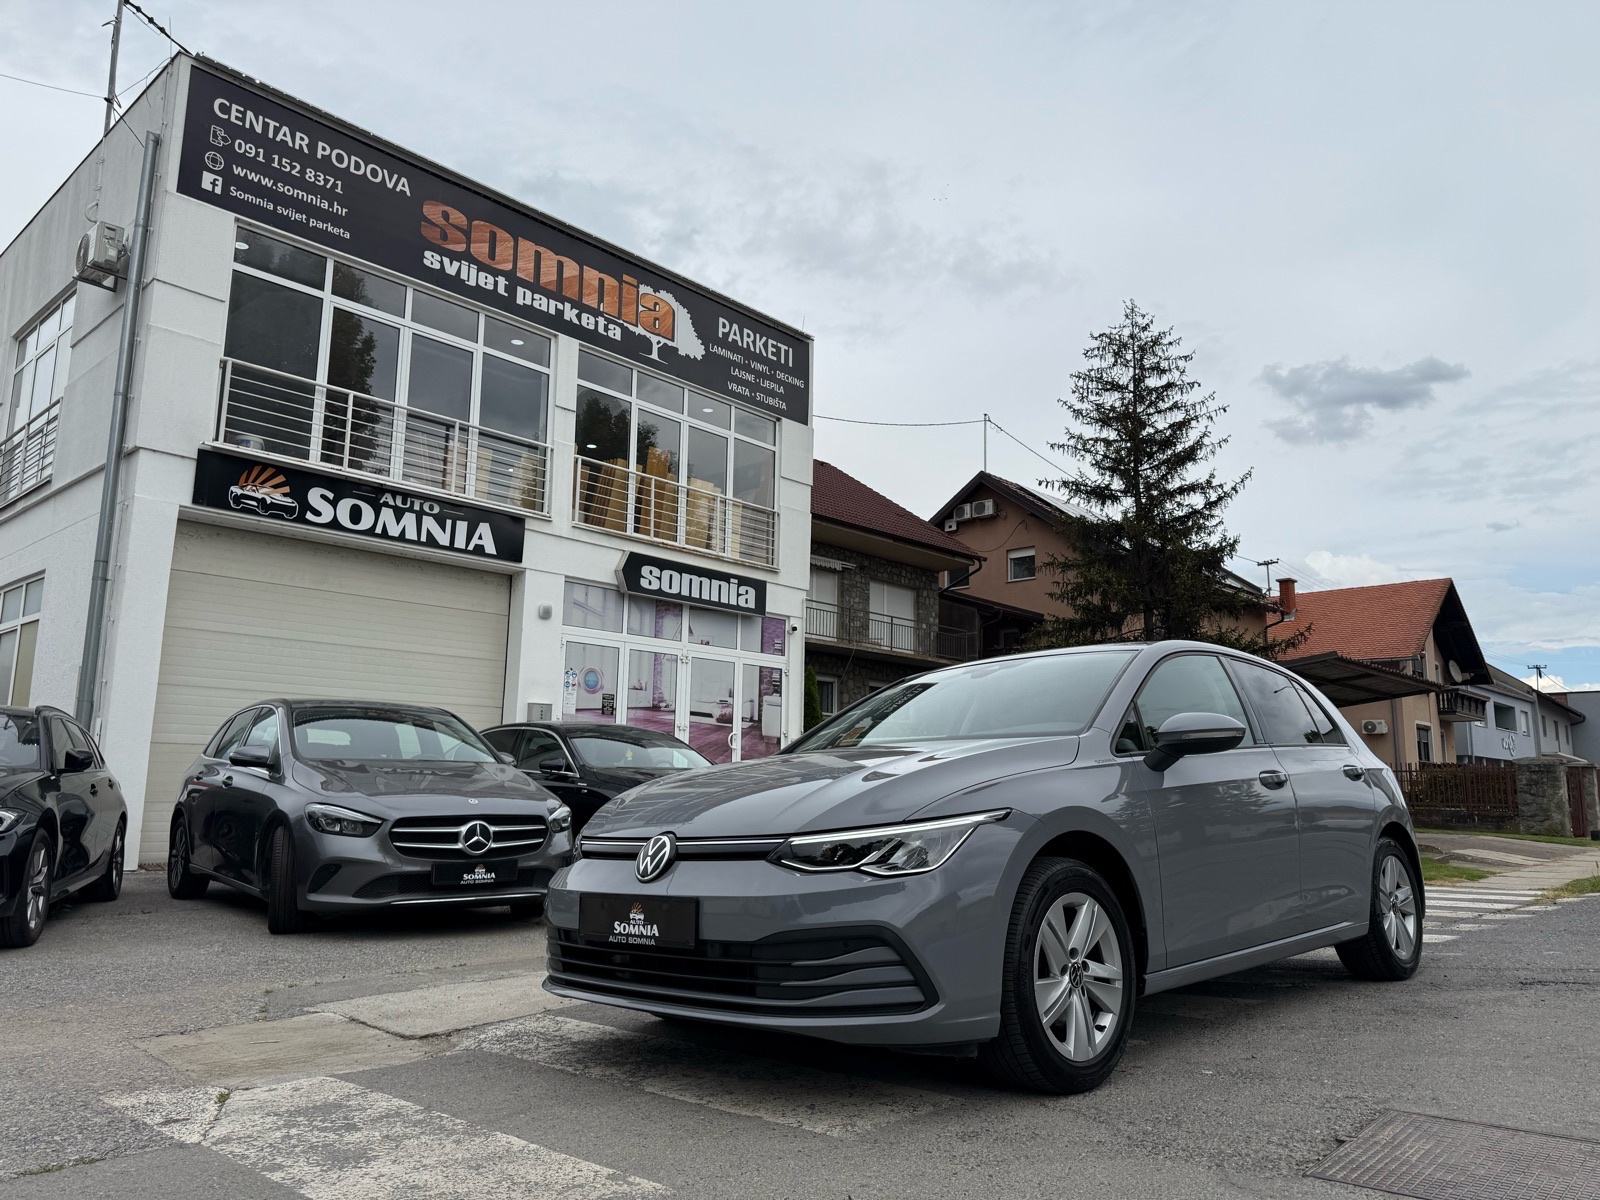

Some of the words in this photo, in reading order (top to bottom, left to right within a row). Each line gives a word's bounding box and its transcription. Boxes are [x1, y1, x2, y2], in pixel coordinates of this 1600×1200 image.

[213, 98, 309, 153] CENTAR
[317, 141, 411, 197] PODOVA
[234, 139, 265, 163] 091
[271, 154, 301, 177] 152
[305, 169, 343, 194] 8371
[229, 186, 274, 211] Somnia
[276, 204, 307, 224] svijet
[309, 218, 350, 240] parketa
[232, 164, 349, 217] www.somnia.hr
[420, 200, 676, 342] somnia
[423, 250, 508, 297] svijet
[516, 285, 622, 342] parketa
[709, 343, 744, 364] LAMINATI
[750, 360, 771, 375] VINYL
[776, 370, 805, 388] DECKING
[718, 316, 793, 367] PARKETI
[727, 381, 750, 397] VRATA
[755, 392, 787, 411] STUBIŠTA
[730, 366, 755, 383] LAJSNE
[760, 378, 785, 394] LJEPILA
[305, 486, 498, 556] SOMNIA
[380, 492, 440, 515] AUTO
[639, 565, 756, 609] somnia
[463, 872, 496, 880] SOMNIA
[608, 935, 627, 943] AUTO
[628, 936, 656, 946] SOMNIA
[613, 921, 660, 937] SOMNIA
